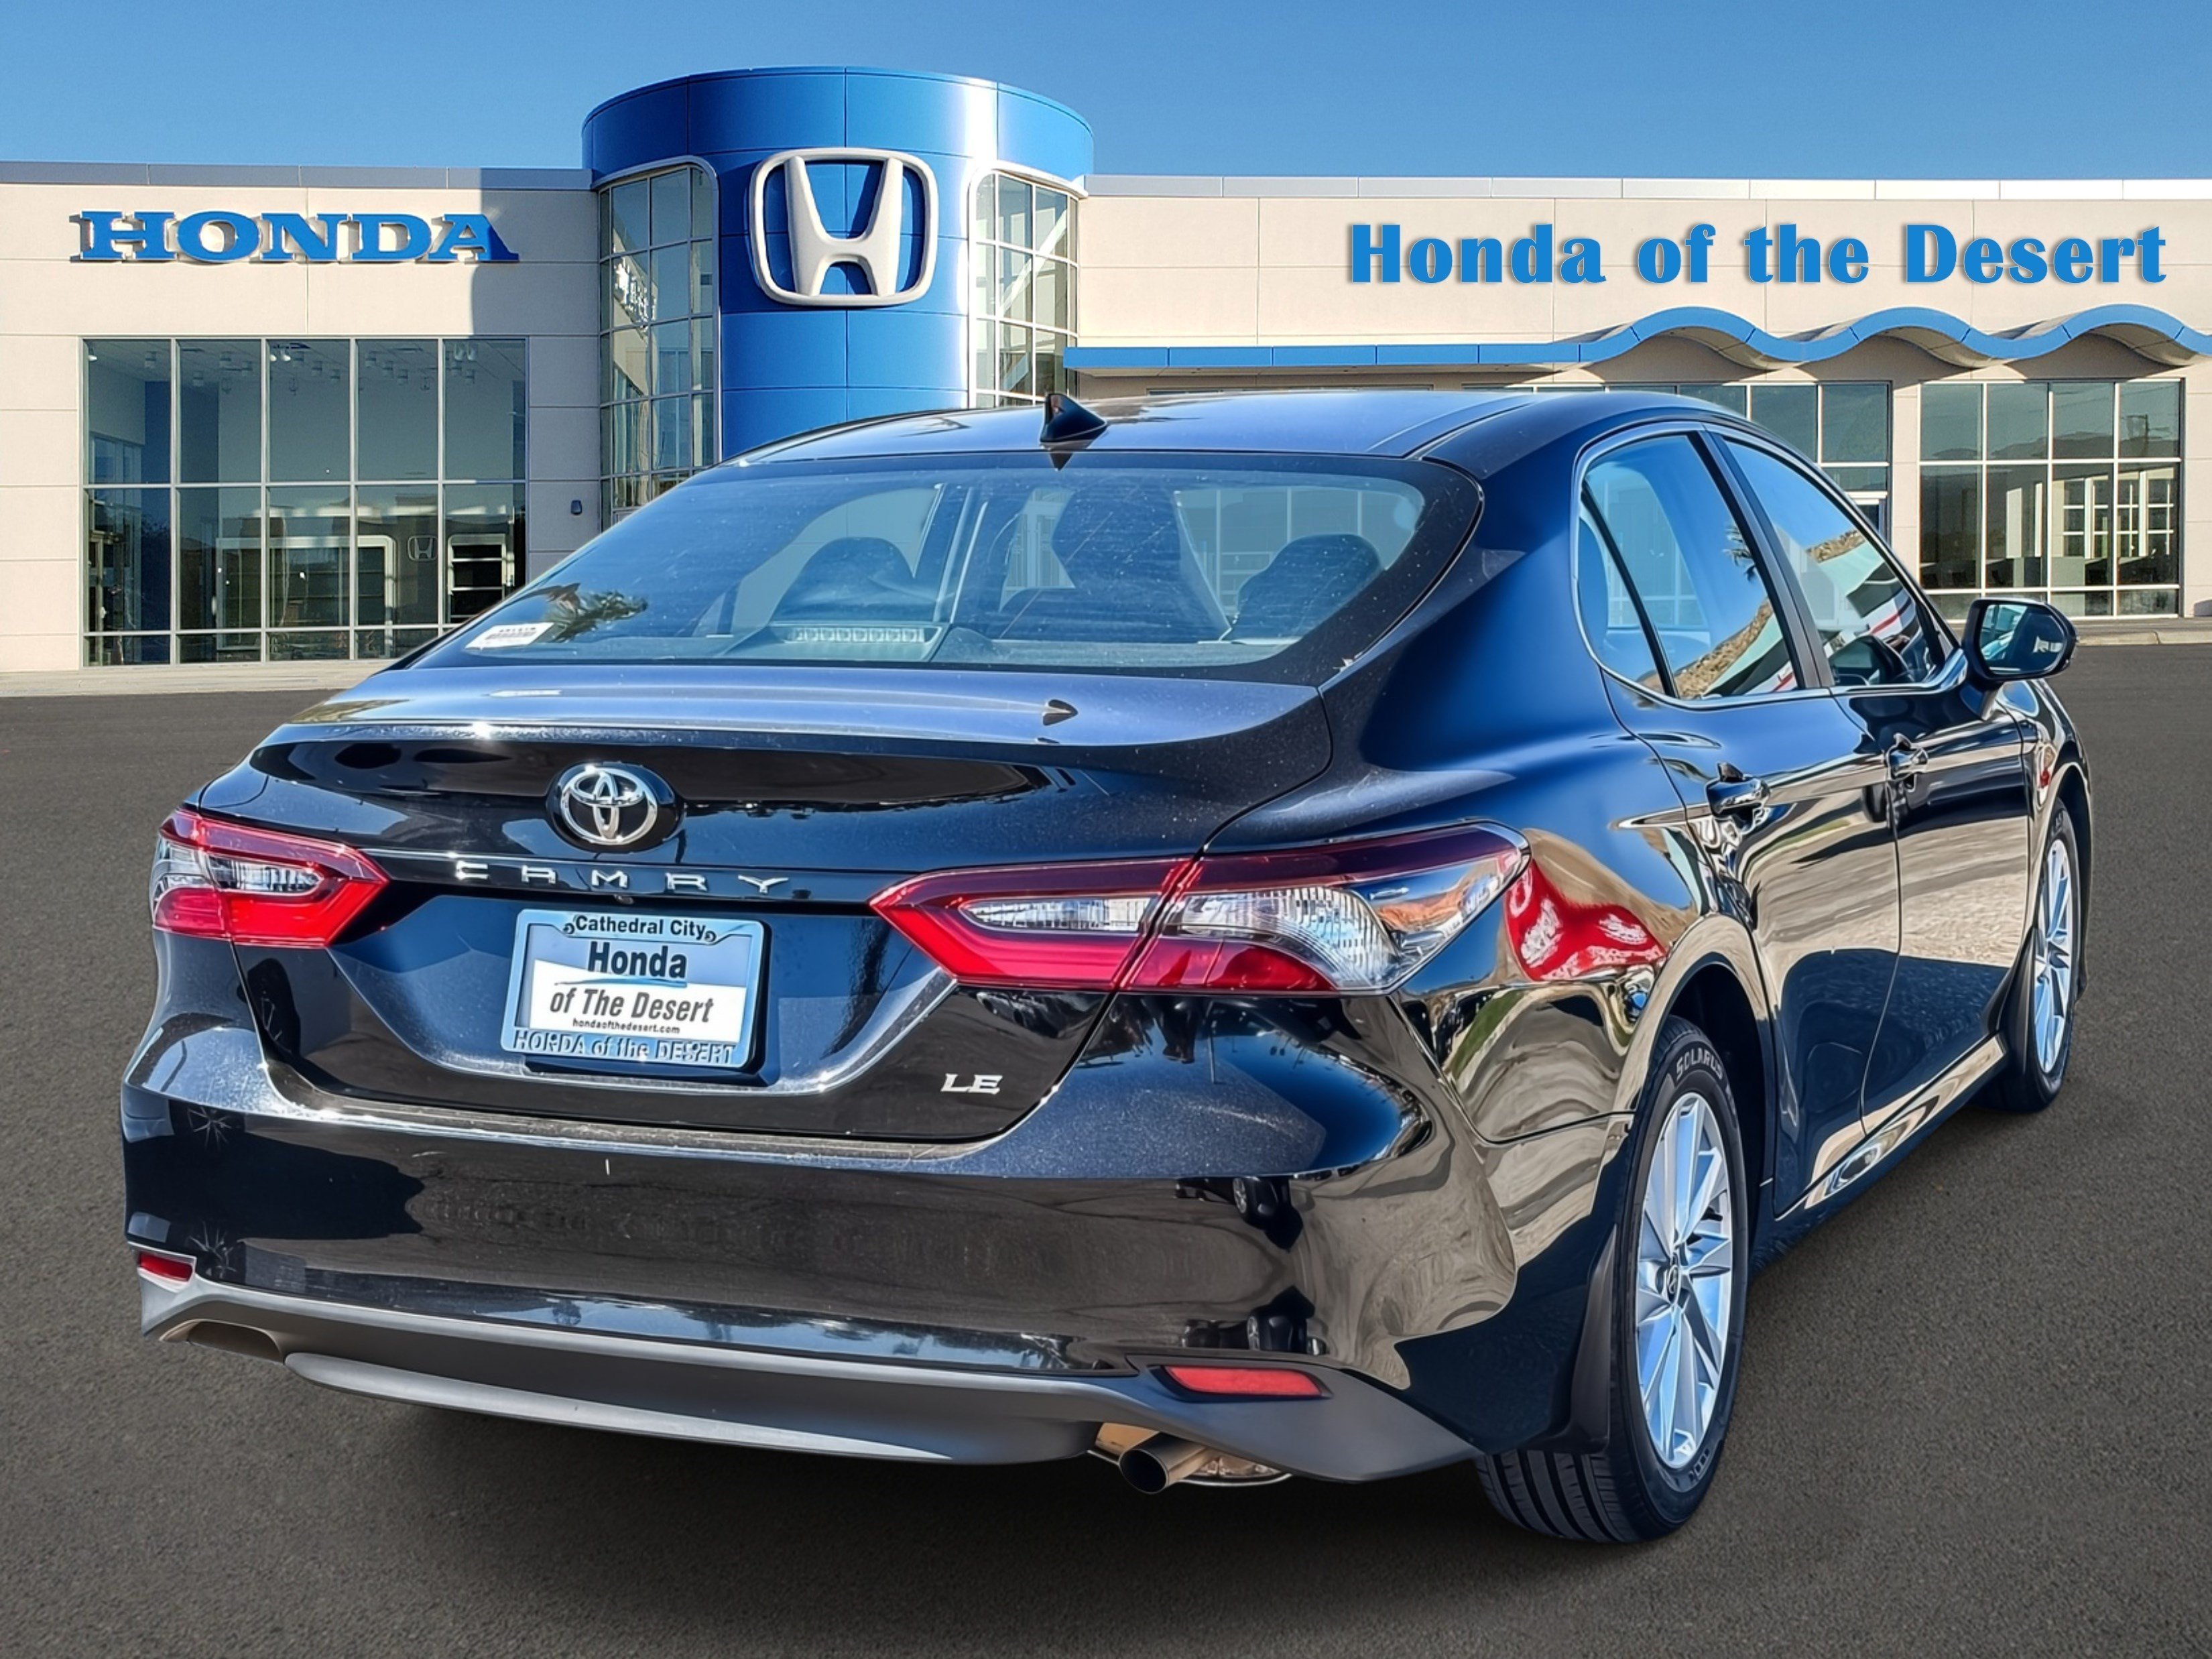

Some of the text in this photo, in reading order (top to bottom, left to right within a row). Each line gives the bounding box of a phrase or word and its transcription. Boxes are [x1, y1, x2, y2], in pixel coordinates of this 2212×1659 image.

[79, 210, 519, 262] HONDA
[1351, 223, 2166, 283] Honda of the Desert
[454, 860, 789, 894] CAMRY
[574, 914, 706, 940] Cathedral City
[587, 940, 688, 979] Honda
[549, 987, 715, 1024] of The Desert
[572, 1018, 681, 1035] hondaofthedesert.com
[513, 1030, 736, 1064] HONDA of the DESERT
[940, 1072, 1003, 1095] LE
